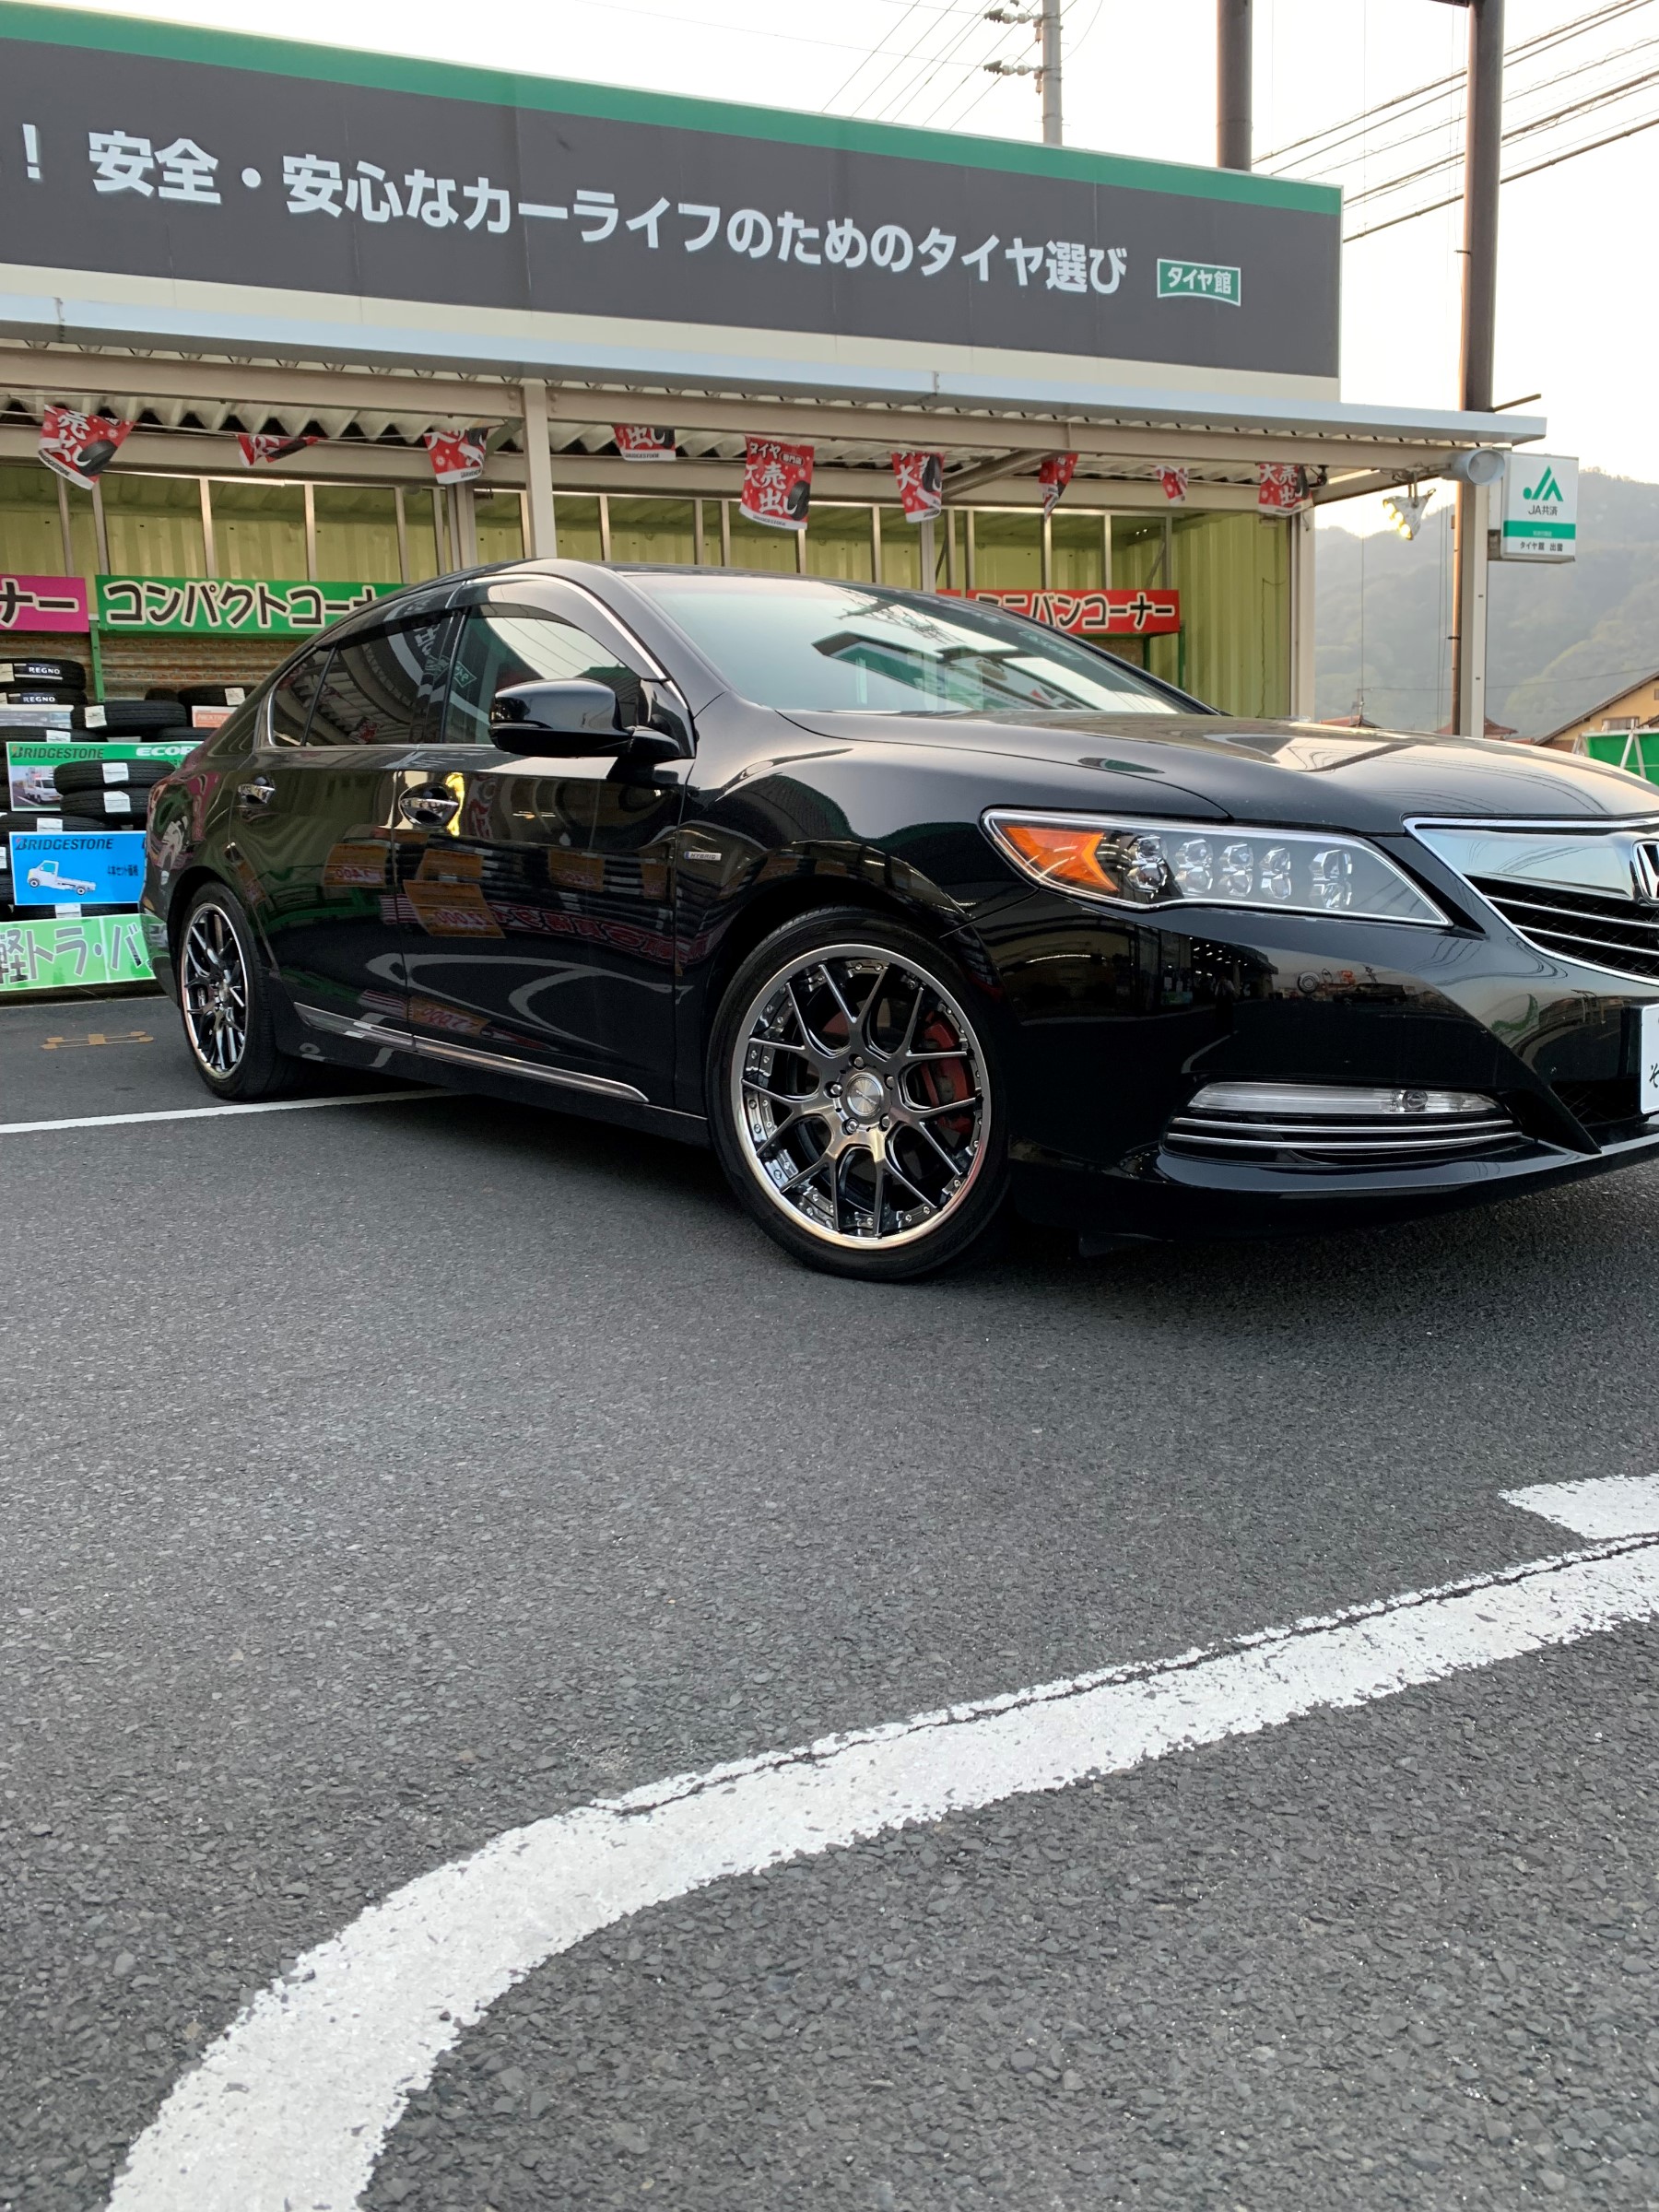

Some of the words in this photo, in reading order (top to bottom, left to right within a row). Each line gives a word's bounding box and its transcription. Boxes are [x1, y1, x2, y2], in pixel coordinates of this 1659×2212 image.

[88, 129, 1127, 295] 安全・安心なカーライフのためのタイヤ選び
[1167, 266, 1232, 295] タイヤ館
[749, 441, 782, 460] タイヤ
[1527, 504, 1559, 516] JA共済
[28, 666, 61, 675] REGNO
[11, 747, 104, 759] BRIDGESTONE
[15, 837, 114, 851] BRIDGESTONE
